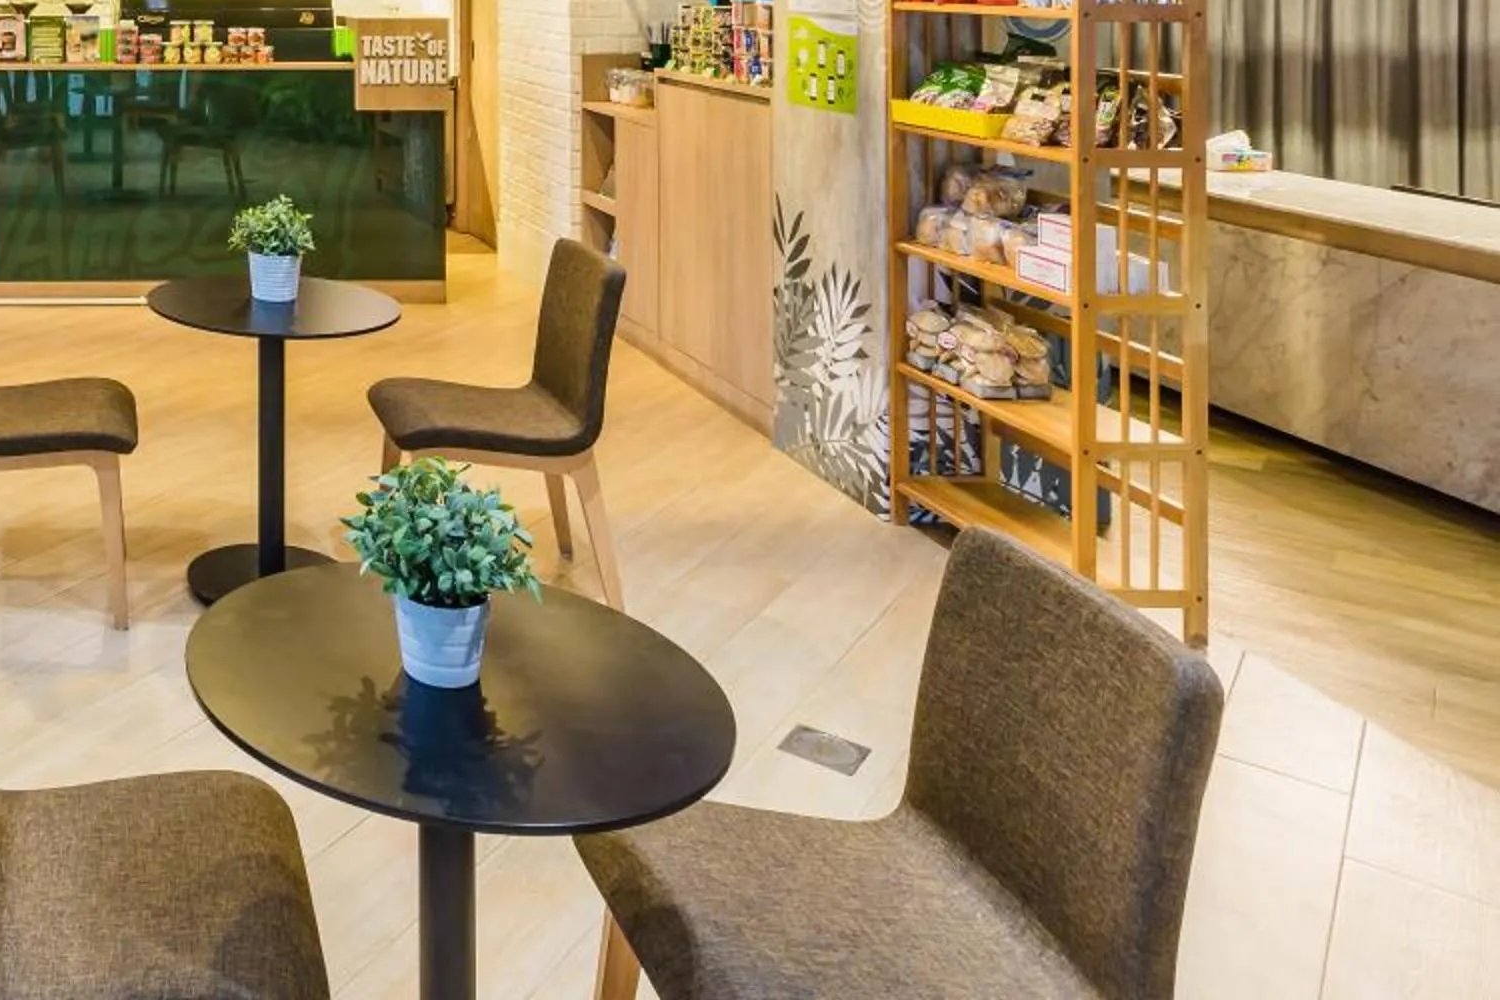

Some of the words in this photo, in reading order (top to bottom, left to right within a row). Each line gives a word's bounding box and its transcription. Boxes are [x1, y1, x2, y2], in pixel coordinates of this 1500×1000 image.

[360, 35, 416, 57] TASTE
[427, 39, 447, 57] OF
[360, 59, 447, 85] NATURE
